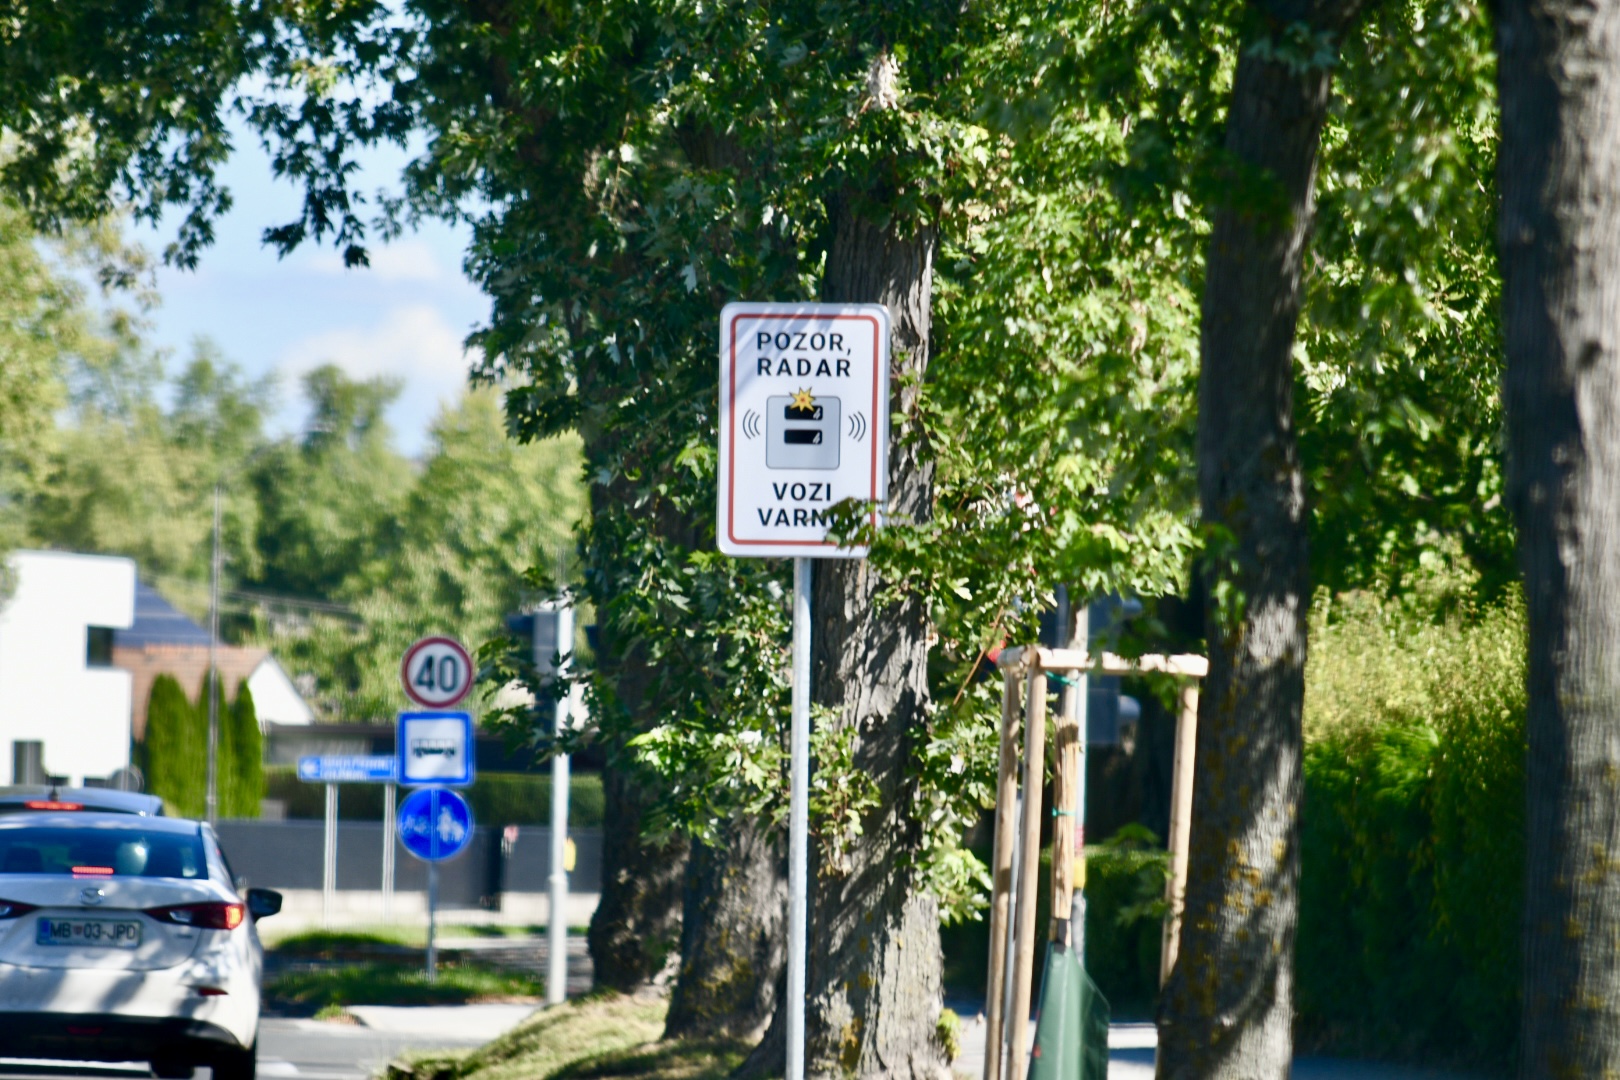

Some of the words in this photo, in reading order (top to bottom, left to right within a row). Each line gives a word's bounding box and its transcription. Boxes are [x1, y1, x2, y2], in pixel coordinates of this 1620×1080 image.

[757, 332, 851, 356] POZOR,
[757, 358, 851, 377] RADAR
[772, 482, 831, 501] VOZI
[415, 655, 458, 693] 40
[50, 922, 71, 938] MB
